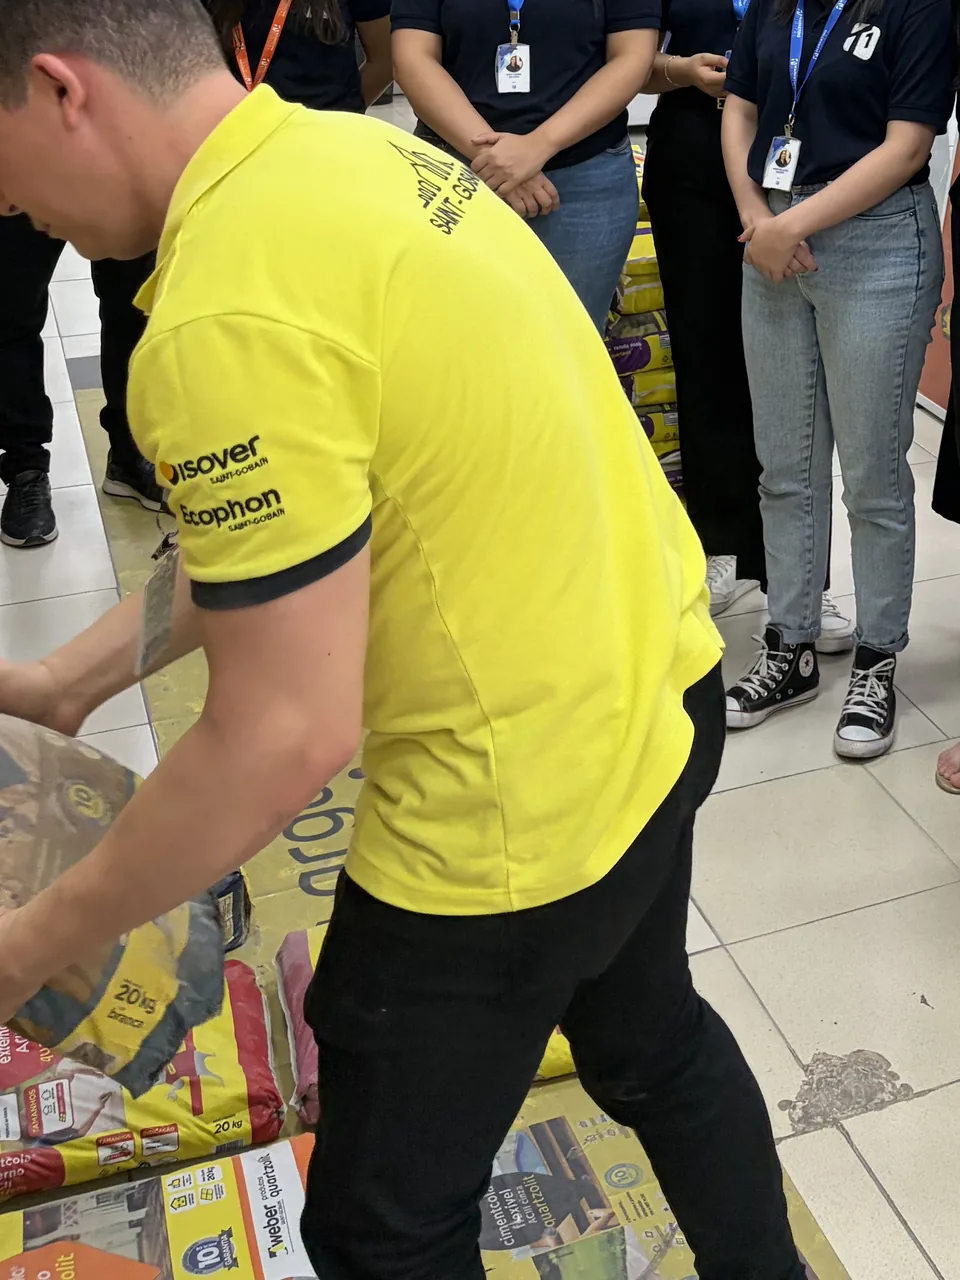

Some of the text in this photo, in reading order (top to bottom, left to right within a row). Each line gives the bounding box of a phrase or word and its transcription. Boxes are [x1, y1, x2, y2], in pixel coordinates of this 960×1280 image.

[209, 456, 269, 485] SAINT-GOBAIN
[179, 488, 282, 529] Ecophon
[228, 507, 286, 532] SAINT-GOBAIN
[114, 983, 140, 1005] 20
[28, 1089, 41, 1134] TAMANHOS
[214, 1119, 243, 1135] 20 kg
[486, 1184, 515, 1246] cimentcola
[522, 1174, 556, 1228] quartzolit
[262, 1204, 284, 1248] weber
[196, 1247, 221, 1270] 10
[220, 1233, 235, 1267] GARANTIA
